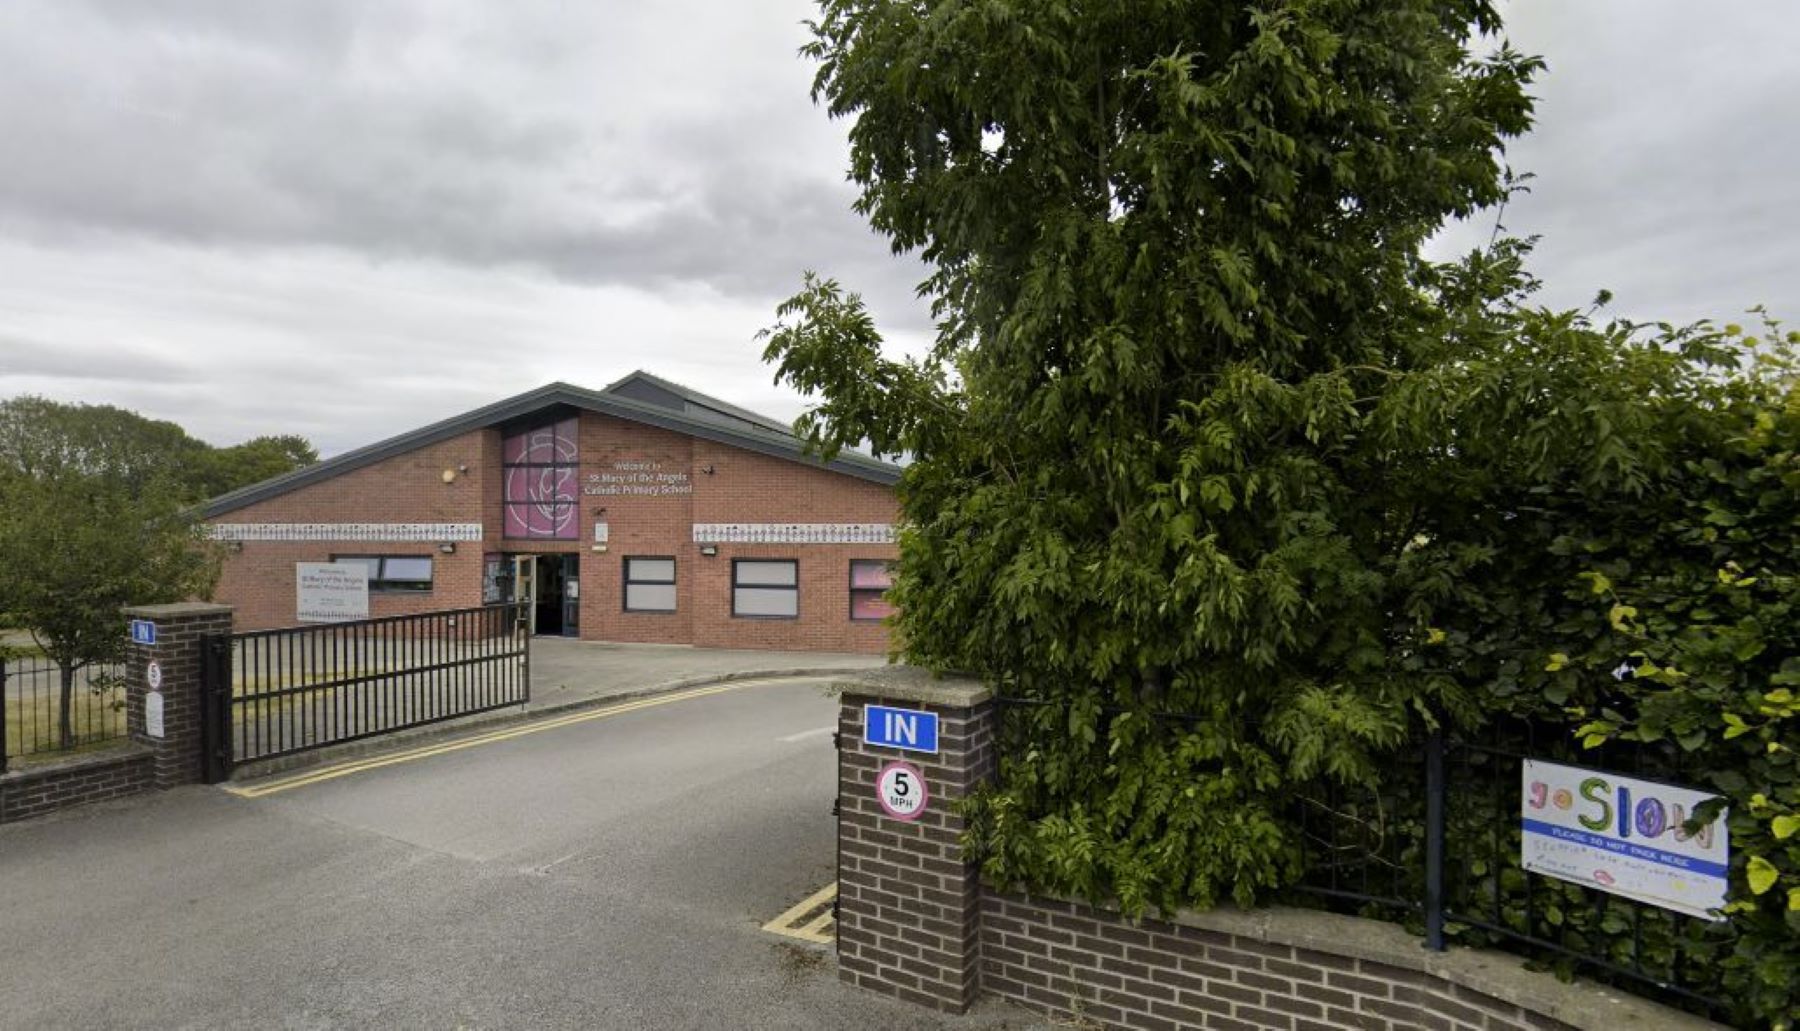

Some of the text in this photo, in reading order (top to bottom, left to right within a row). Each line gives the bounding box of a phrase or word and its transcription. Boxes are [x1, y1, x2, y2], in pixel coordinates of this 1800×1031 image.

[601, 473, 625, 483] Mary
[628, 473, 637, 482] of
[638, 473, 654, 482] the
[656, 472, 688, 484] Angels
[622, 485, 659, 496] Primary
[661, 484, 693, 494] School
[884, 712, 917, 745] IN
[893, 771, 909, 796] 5
[890, 796, 913, 808] MPH
[1552, 827, 1586, 844] PLEASE
[1607, 840, 1627, 852] NOT
[1631, 844, 1657, 859] PARK
[1660, 853, 1691, 867] HERE
